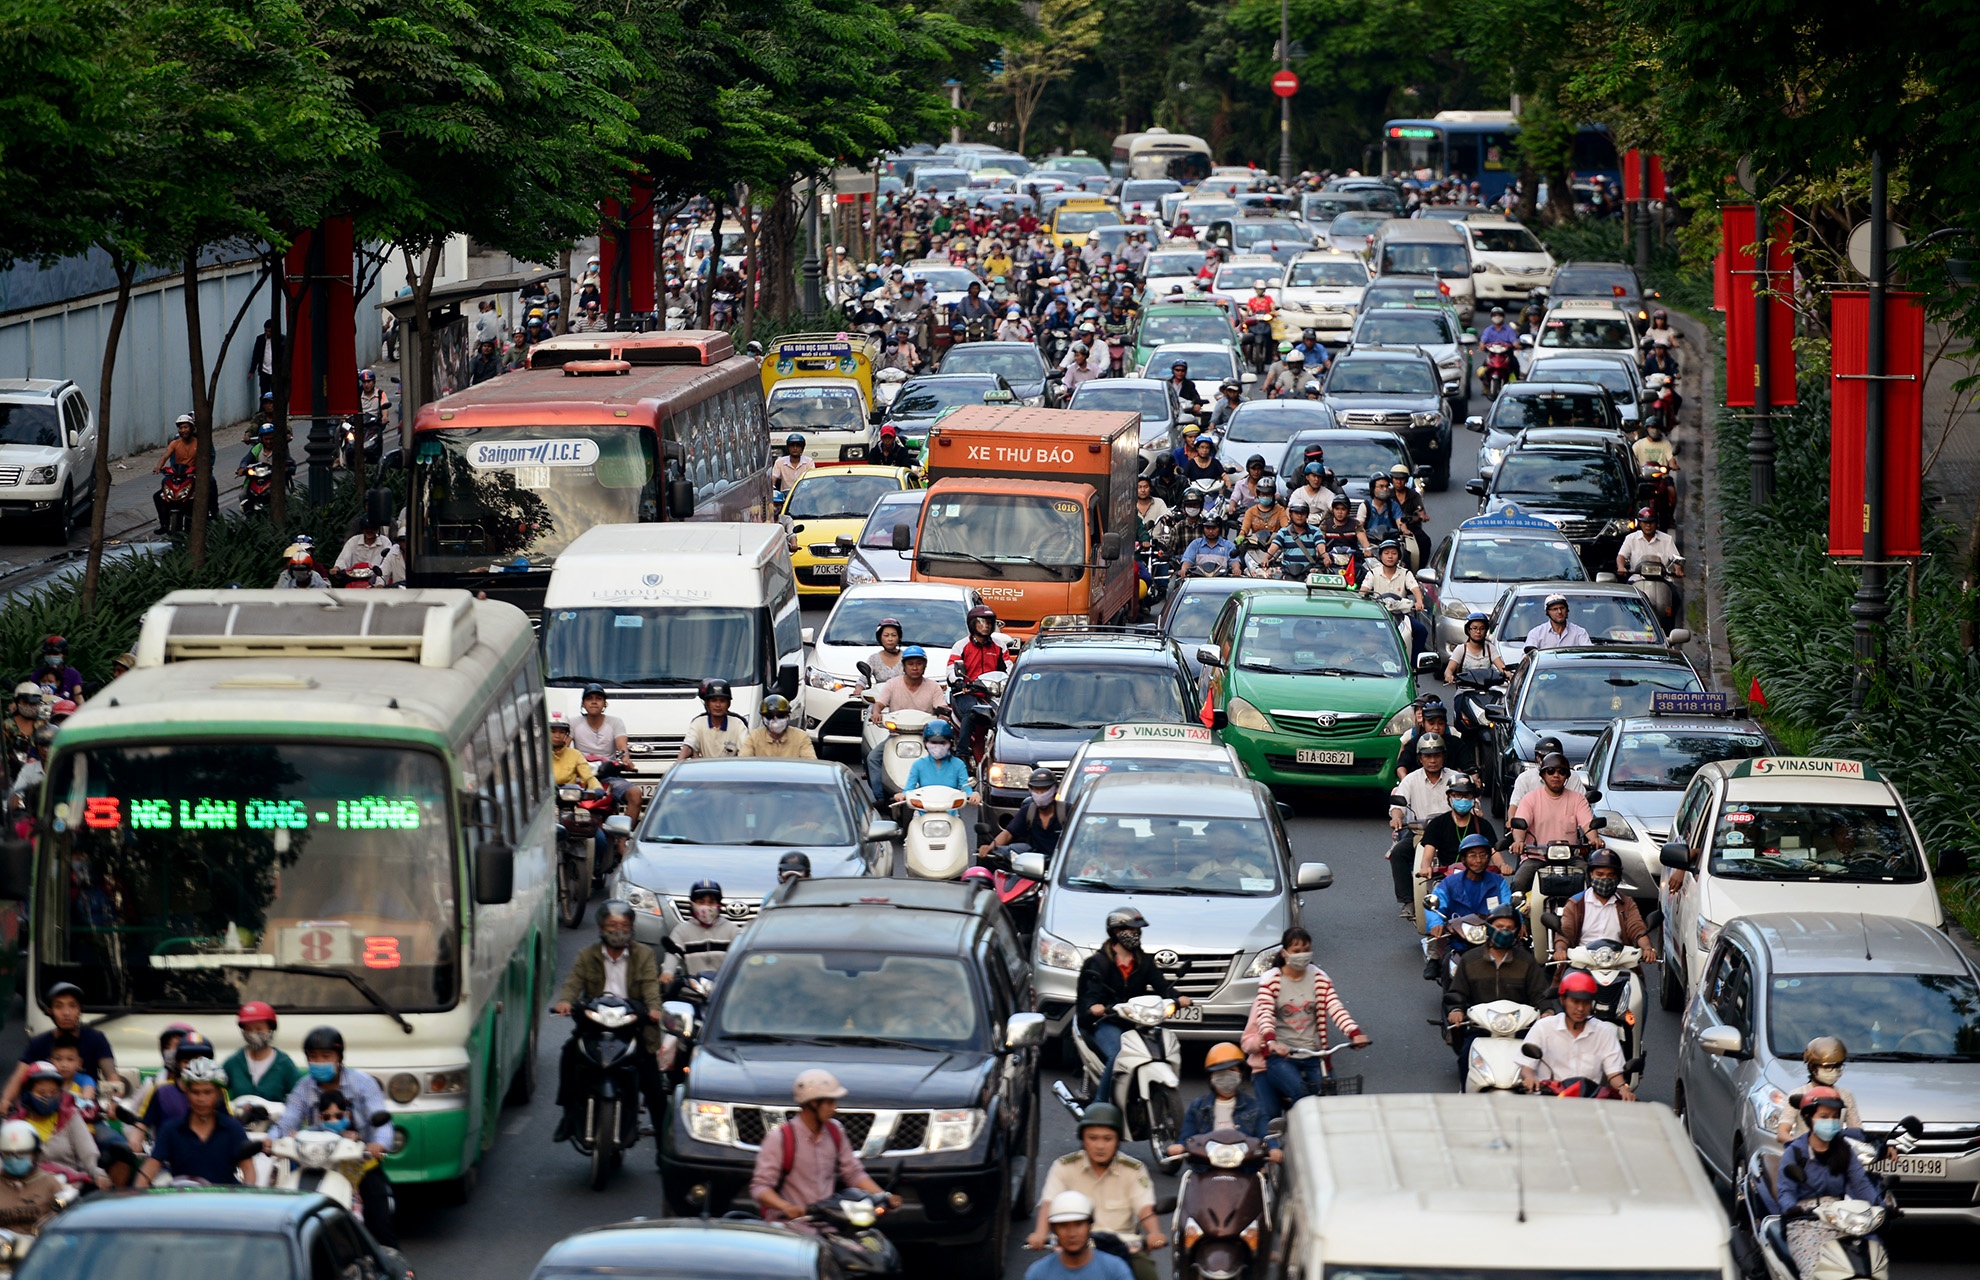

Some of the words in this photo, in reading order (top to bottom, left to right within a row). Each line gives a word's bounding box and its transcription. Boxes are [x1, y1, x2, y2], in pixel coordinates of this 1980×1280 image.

[478, 441, 527, 464] Saigon
[967, 446, 991, 460] XE
[996, 447, 1033, 463] THƯ
[1036, 446, 1074, 463] BÁO
[1056, 503, 1077, 512] 1016
[1311, 575, 1342, 585] TAXI
[592, 588, 713, 598] LIMOUSINE
[1706, 694, 1724, 702] TAXI
[1658, 702, 1674, 711] 38
[1676, 702, 1698, 711] 118
[1700, 702, 1722, 712] 118
[300, 930, 334, 961] 8
